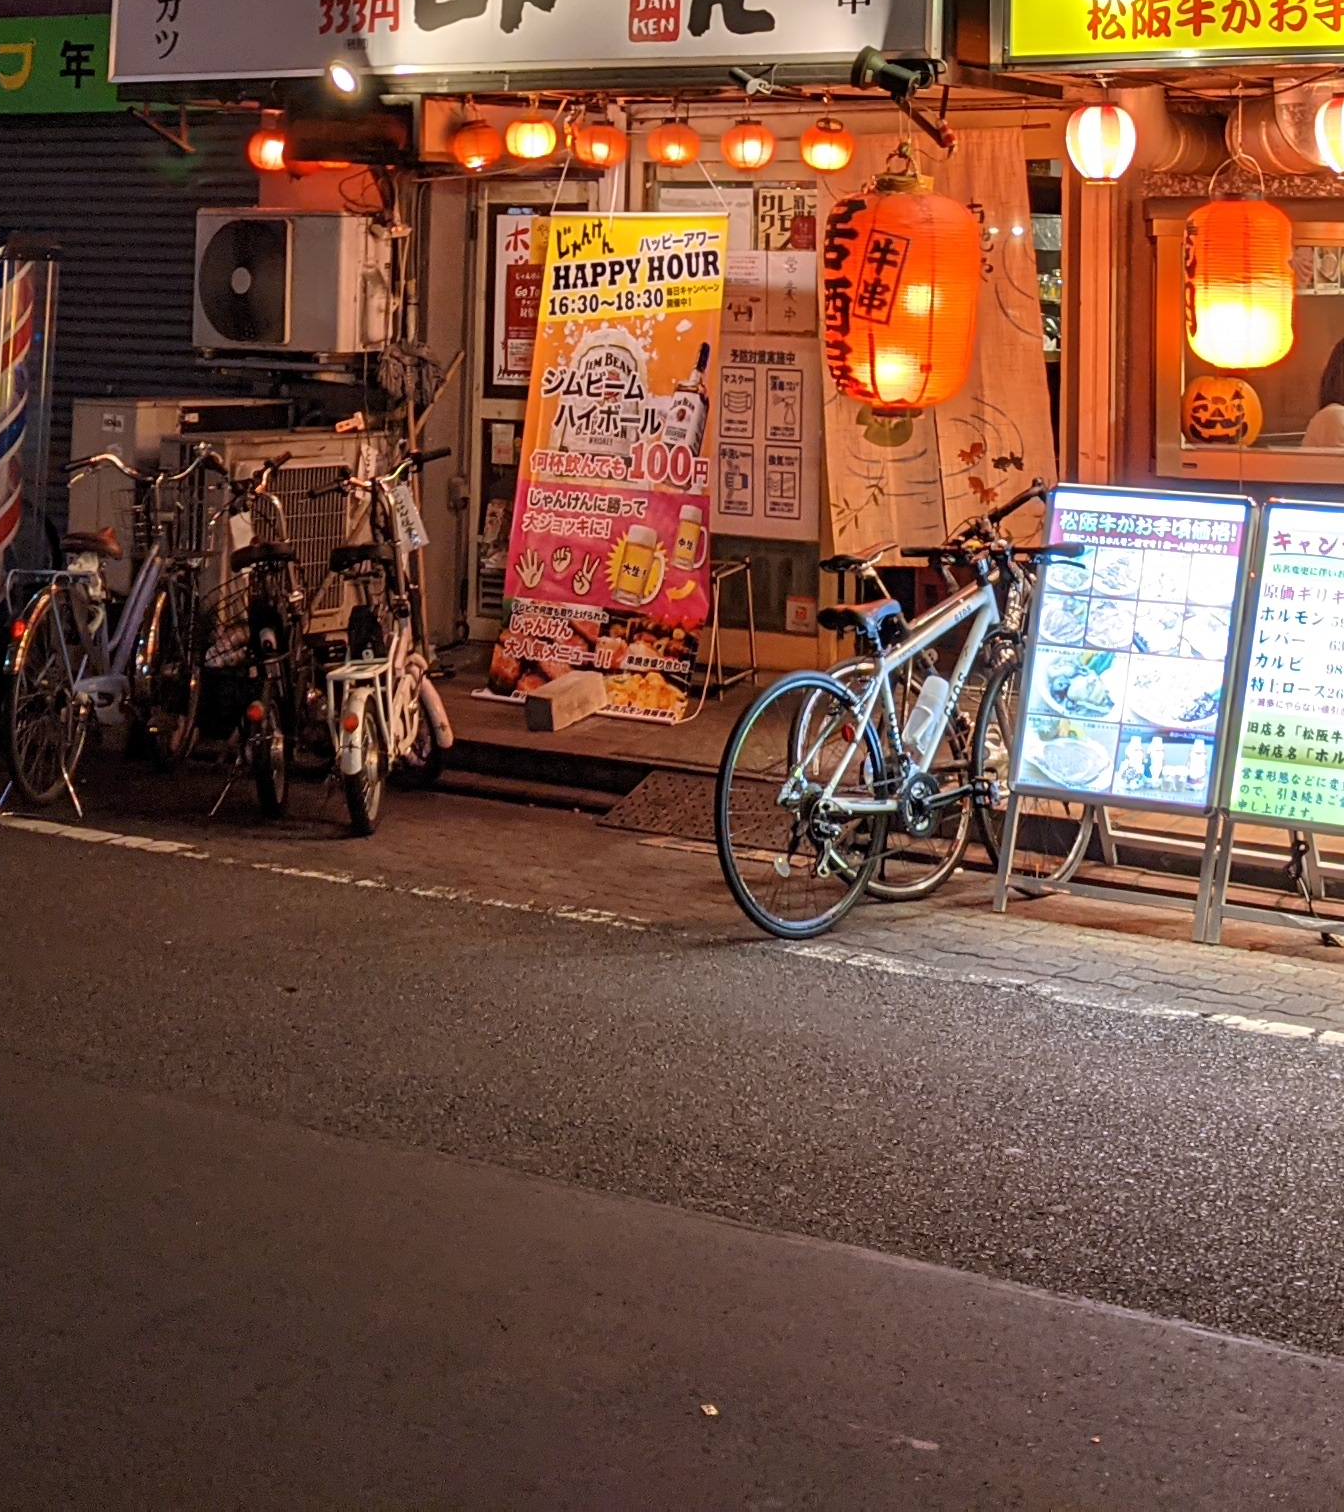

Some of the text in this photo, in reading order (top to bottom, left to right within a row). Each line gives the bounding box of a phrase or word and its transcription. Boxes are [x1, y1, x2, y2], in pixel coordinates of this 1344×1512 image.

[632, 15, 676, 38] KEN
[556, 219, 720, 259] じゃんけん ハッピーアワー
[552, 257, 640, 290] HAPPY
[647, 250, 720, 283] HOUR
[858, 238, 900, 316] 牛串
[543, 369, 645, 400] ジムビーム
[554, 404, 662, 435] ハイボール
[528, 488, 647, 517] じゃんけんに勝って
[509, 615, 573, 638] じゃんけん
[1260, 606, 1324, 626] ホルモン
[1258, 629, 1305, 644] レバー
[1255, 652, 1304, 672] カルビ
